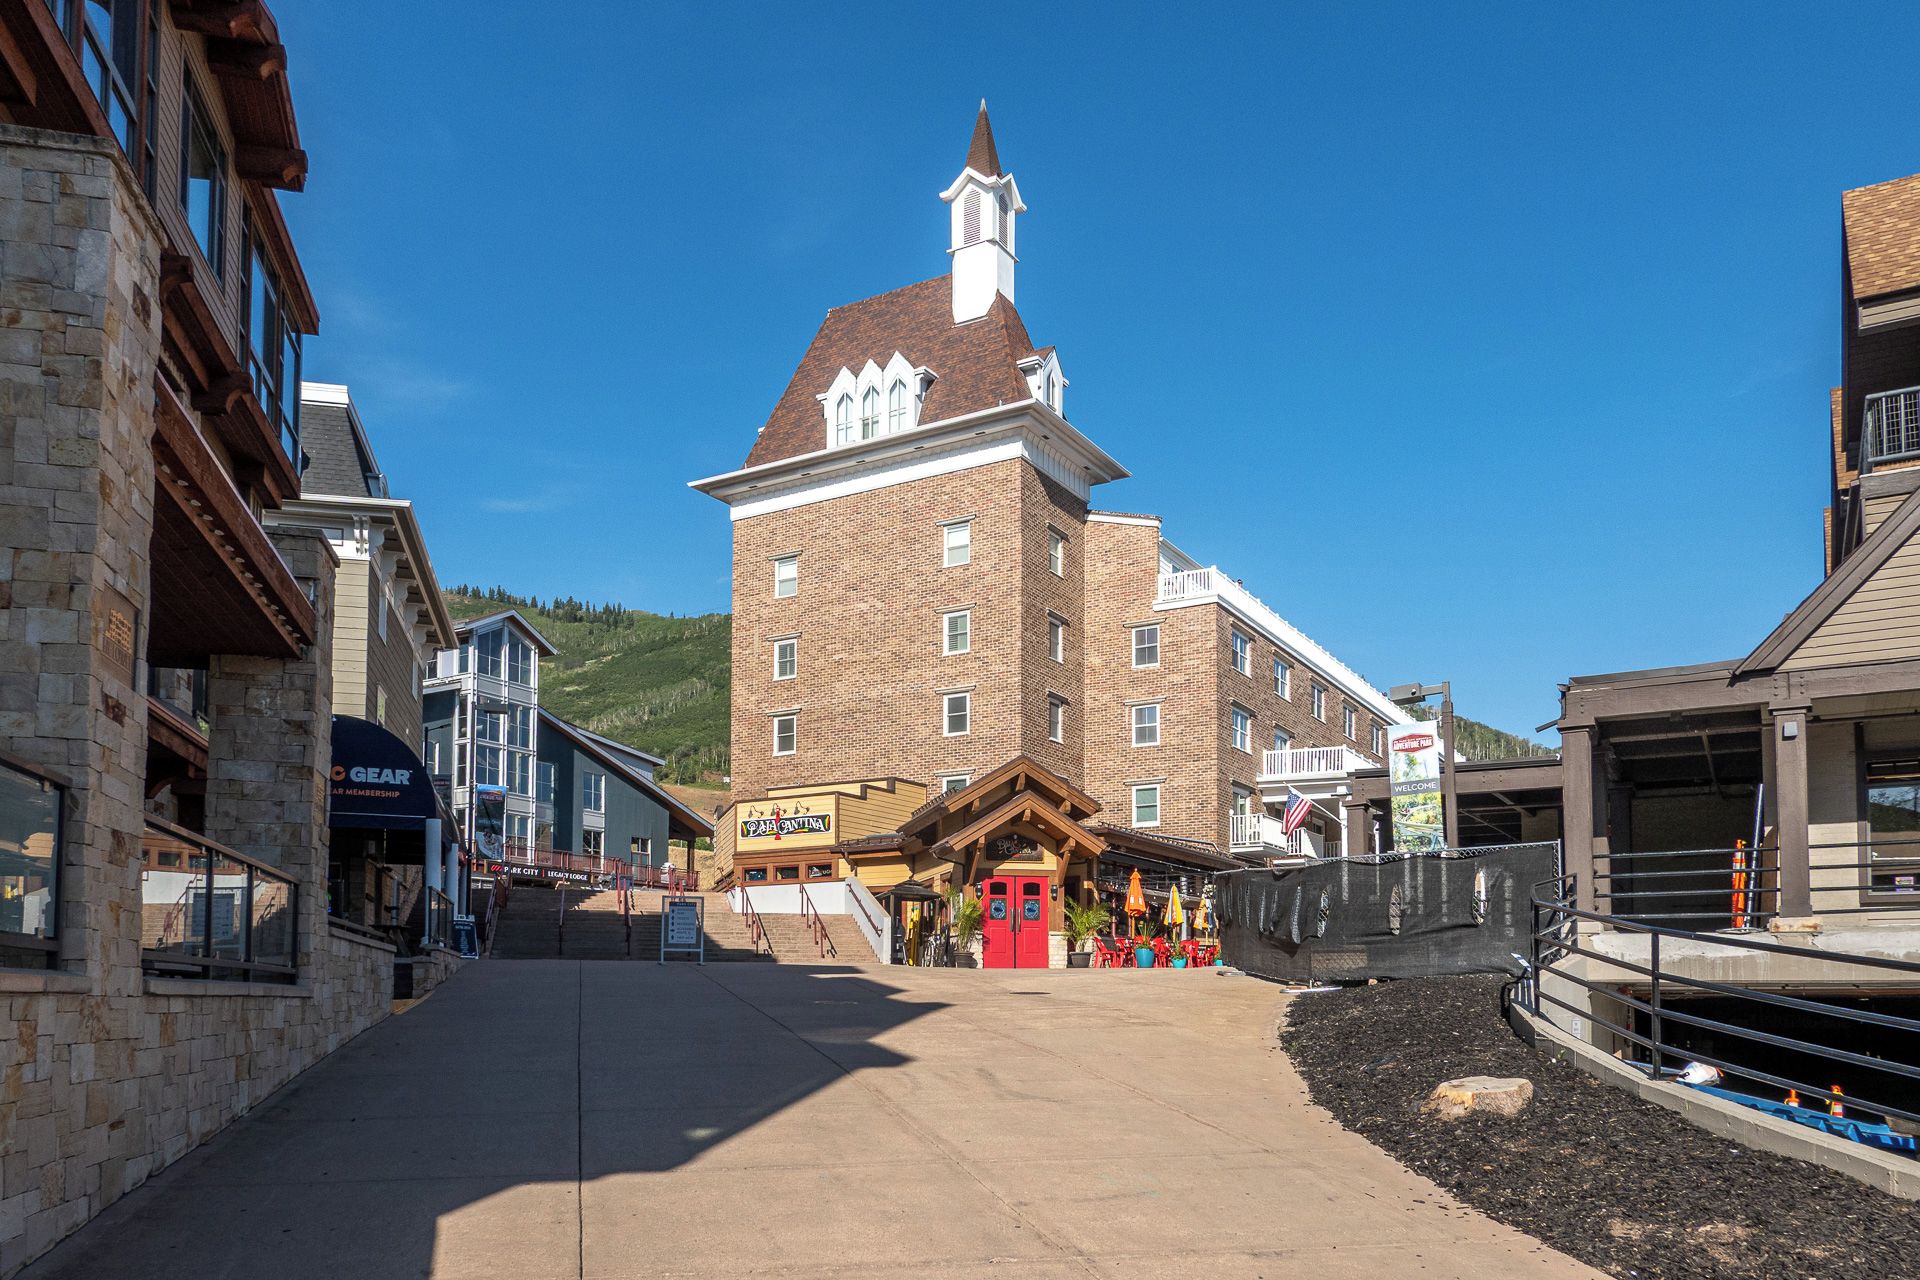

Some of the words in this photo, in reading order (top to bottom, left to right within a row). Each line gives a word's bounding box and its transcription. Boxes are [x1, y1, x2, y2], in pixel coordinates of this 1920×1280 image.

[1420, 738, 1432, 747] PARK
[350, 766, 410, 785] GEAR
[1395, 782, 1437, 792] WELCOME
[346, 788, 400, 798] MEMBERSHIP
[747, 820, 777, 837] BAJA
[778, 817, 826, 834] CANTINA
[523, 868, 539, 876] CITY
[569, 871, 588, 881] LODGE
